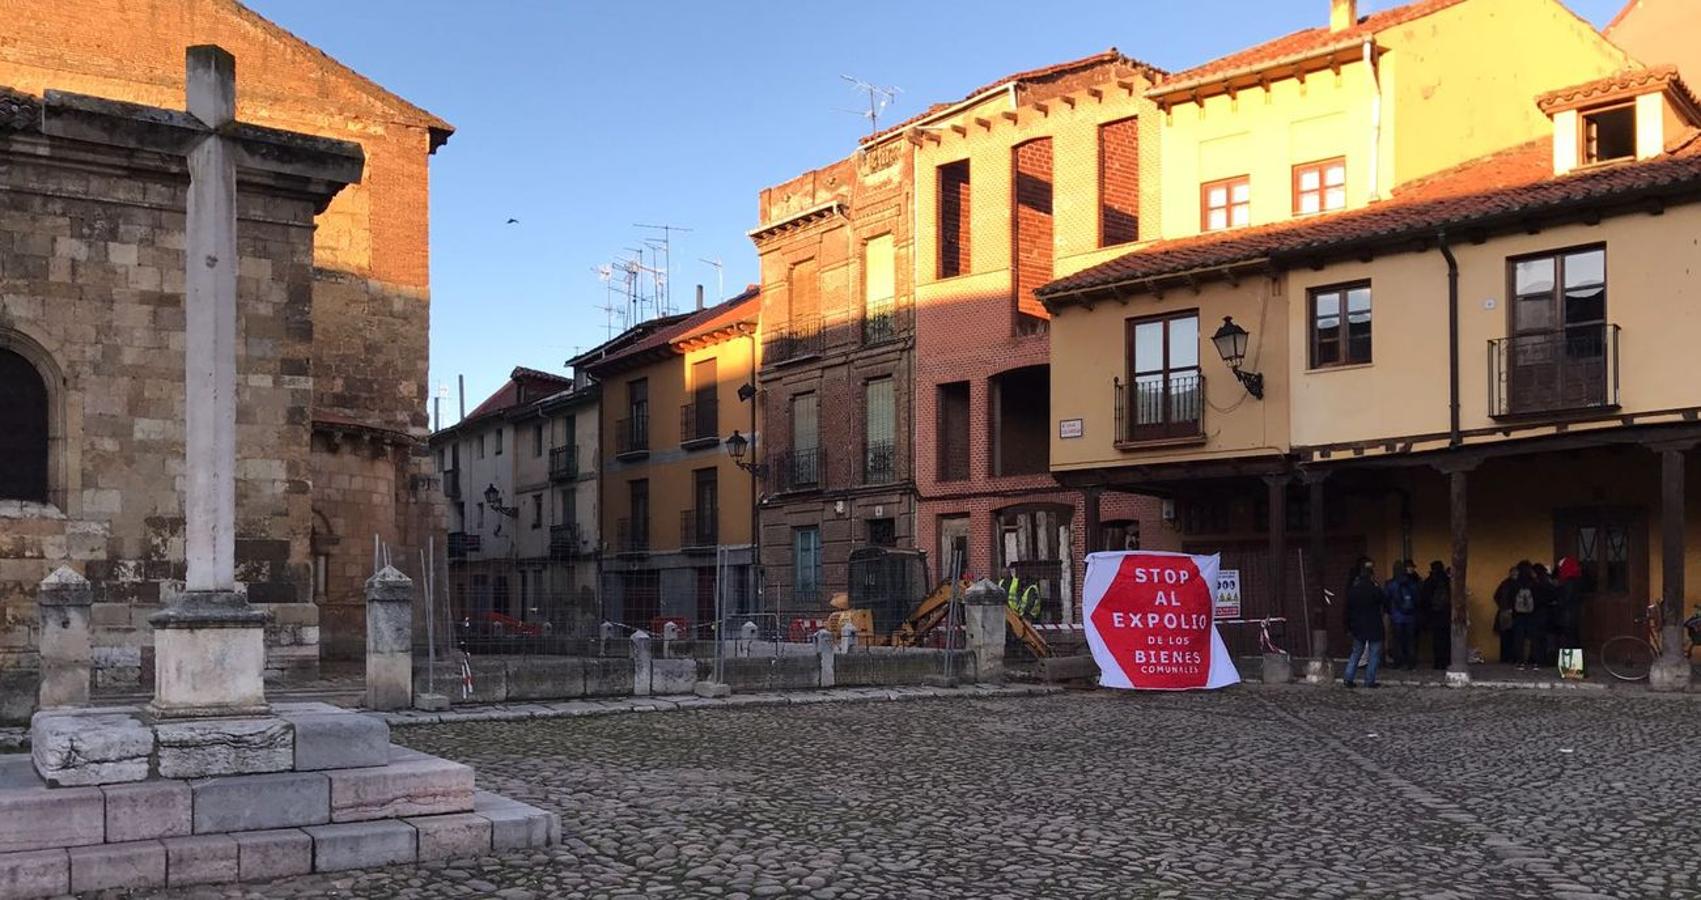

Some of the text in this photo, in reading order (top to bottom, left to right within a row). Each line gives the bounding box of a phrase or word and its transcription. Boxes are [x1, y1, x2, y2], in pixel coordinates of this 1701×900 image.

[1135, 568, 1189, 584] STOP
[1154, 591, 1181, 606] AL
[1112, 612, 1206, 630] EXPOLIO
[1147, 636, 1189, 645] DE LOS
[1135, 650, 1201, 664] BIENES
[1140, 665, 1199, 674] COMUNALES
